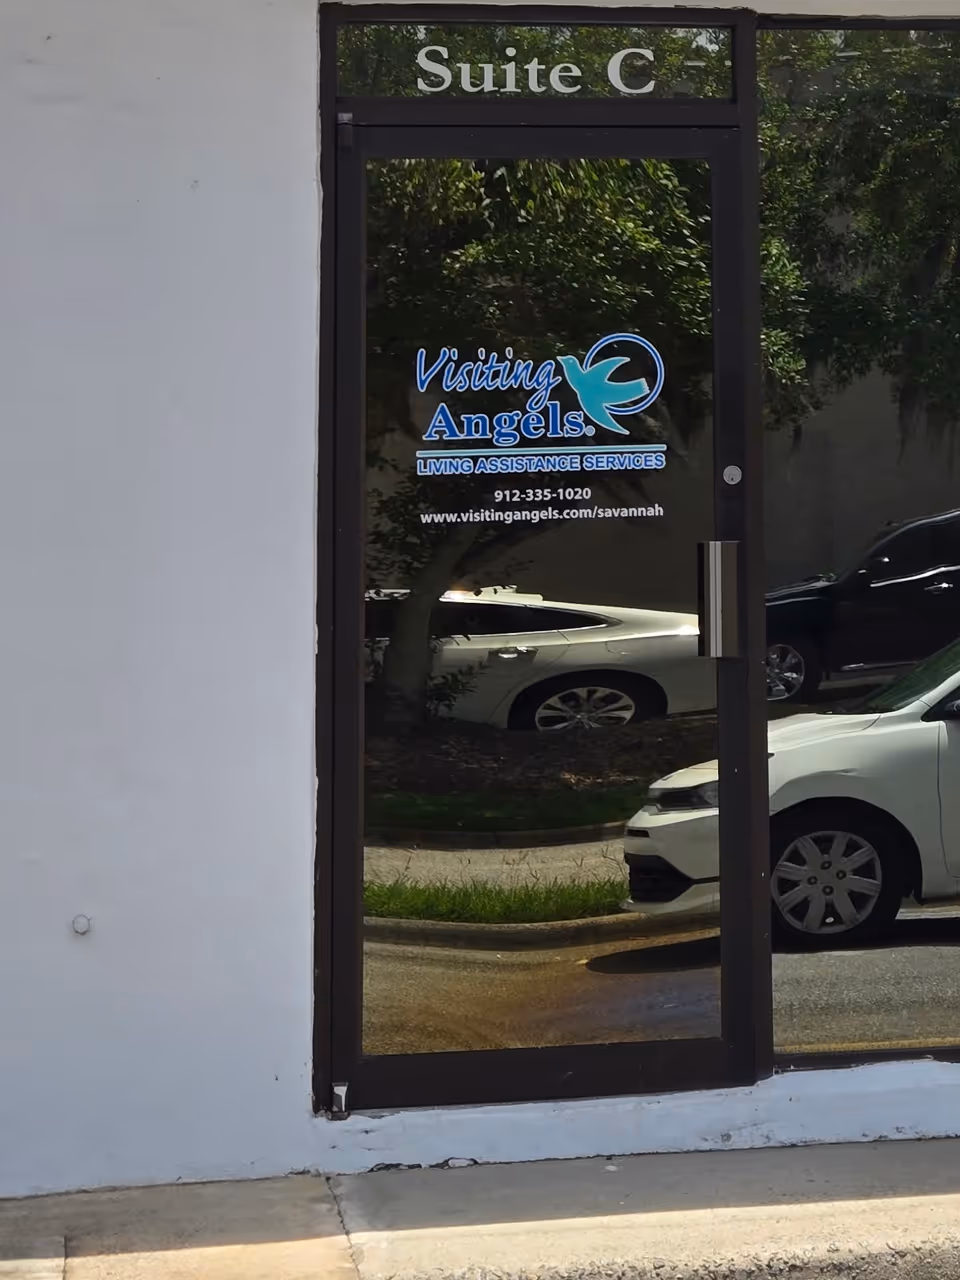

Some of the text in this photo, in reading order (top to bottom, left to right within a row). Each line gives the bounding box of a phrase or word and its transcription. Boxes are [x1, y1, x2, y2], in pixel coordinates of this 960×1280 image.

[415, 45, 656, 95] Suite C
[416, 346, 562, 412] Visiting
[421, 401, 596, 447] Angels
[416, 452, 667, 476] LIVING ASSISTANCE SERVICES
[493, 487, 592, 503] 912-335-1020
[419, 503, 664, 524] www.visitingangels.com/savannah
